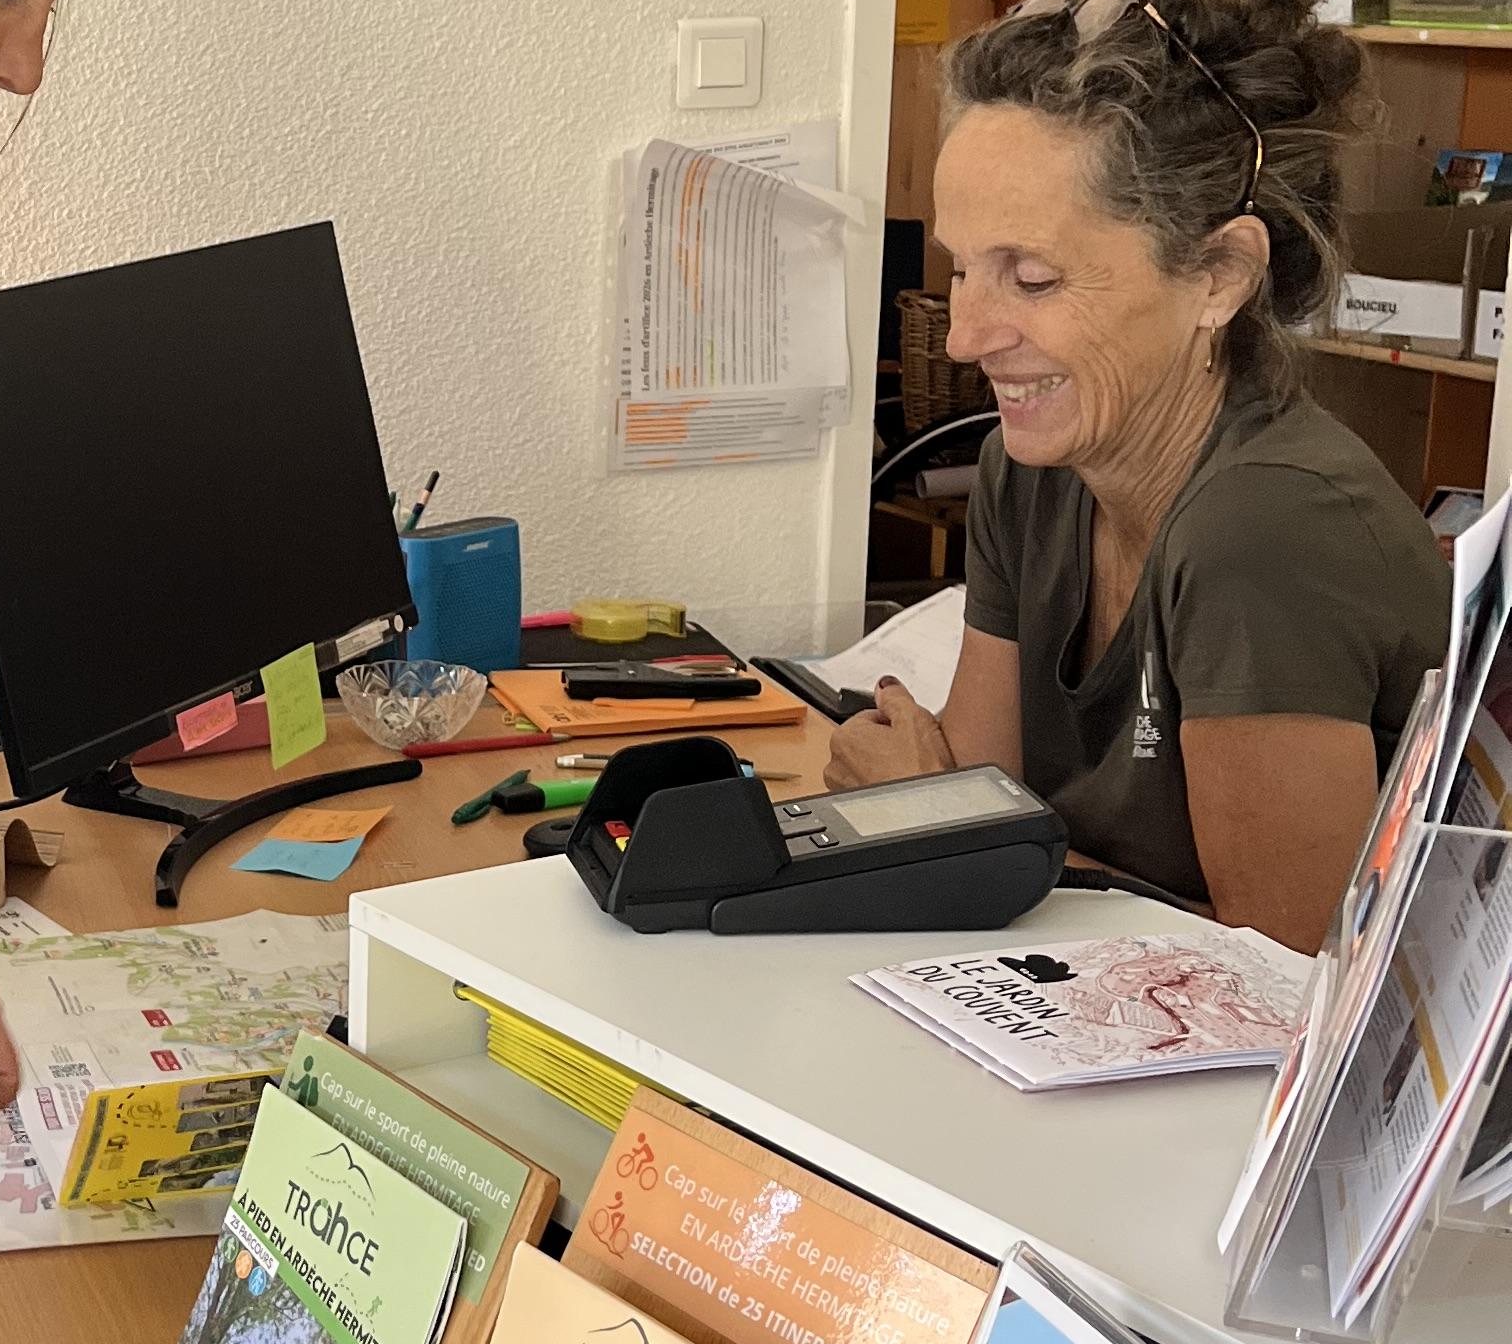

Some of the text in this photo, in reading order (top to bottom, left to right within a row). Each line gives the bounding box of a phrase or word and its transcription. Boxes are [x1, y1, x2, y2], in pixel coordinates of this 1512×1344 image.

[1346, 299, 1397, 314] BOUCIEU
[906, 965, 1059, 1041] DU COUVENT
[950, 959, 1070, 1020] LE JARDIN
[320, 1072, 511, 1209] Cap sur le sport de pleine nature
[331, 1113, 350, 1136] EN
[407, 1164, 481, 1225] HERMITAGE
[238, 1188, 249, 1212] À
[247, 1200, 271, 1234] PIED
[270, 1230, 286, 1252] EN
[283, 1245, 337, 1308] ARDÈCHE
[239, 1225, 273, 1269] PARCOURS
[465, 1248, 486, 1273] IED
[664, 1165, 696, 1196] Cap
[698, 1187, 727, 1213] sur
[730, 1199, 745, 1225] le
[796, 1235, 821, 1266] de
[820, 1252, 880, 1301] pleine
[883, 1289, 952, 1336] nature
[680, 1213, 707, 1242] EN
[630, 1230, 718, 1296] SELECTION
[718, 1279, 740, 1308] de
[741, 1296, 764, 1323] 25
